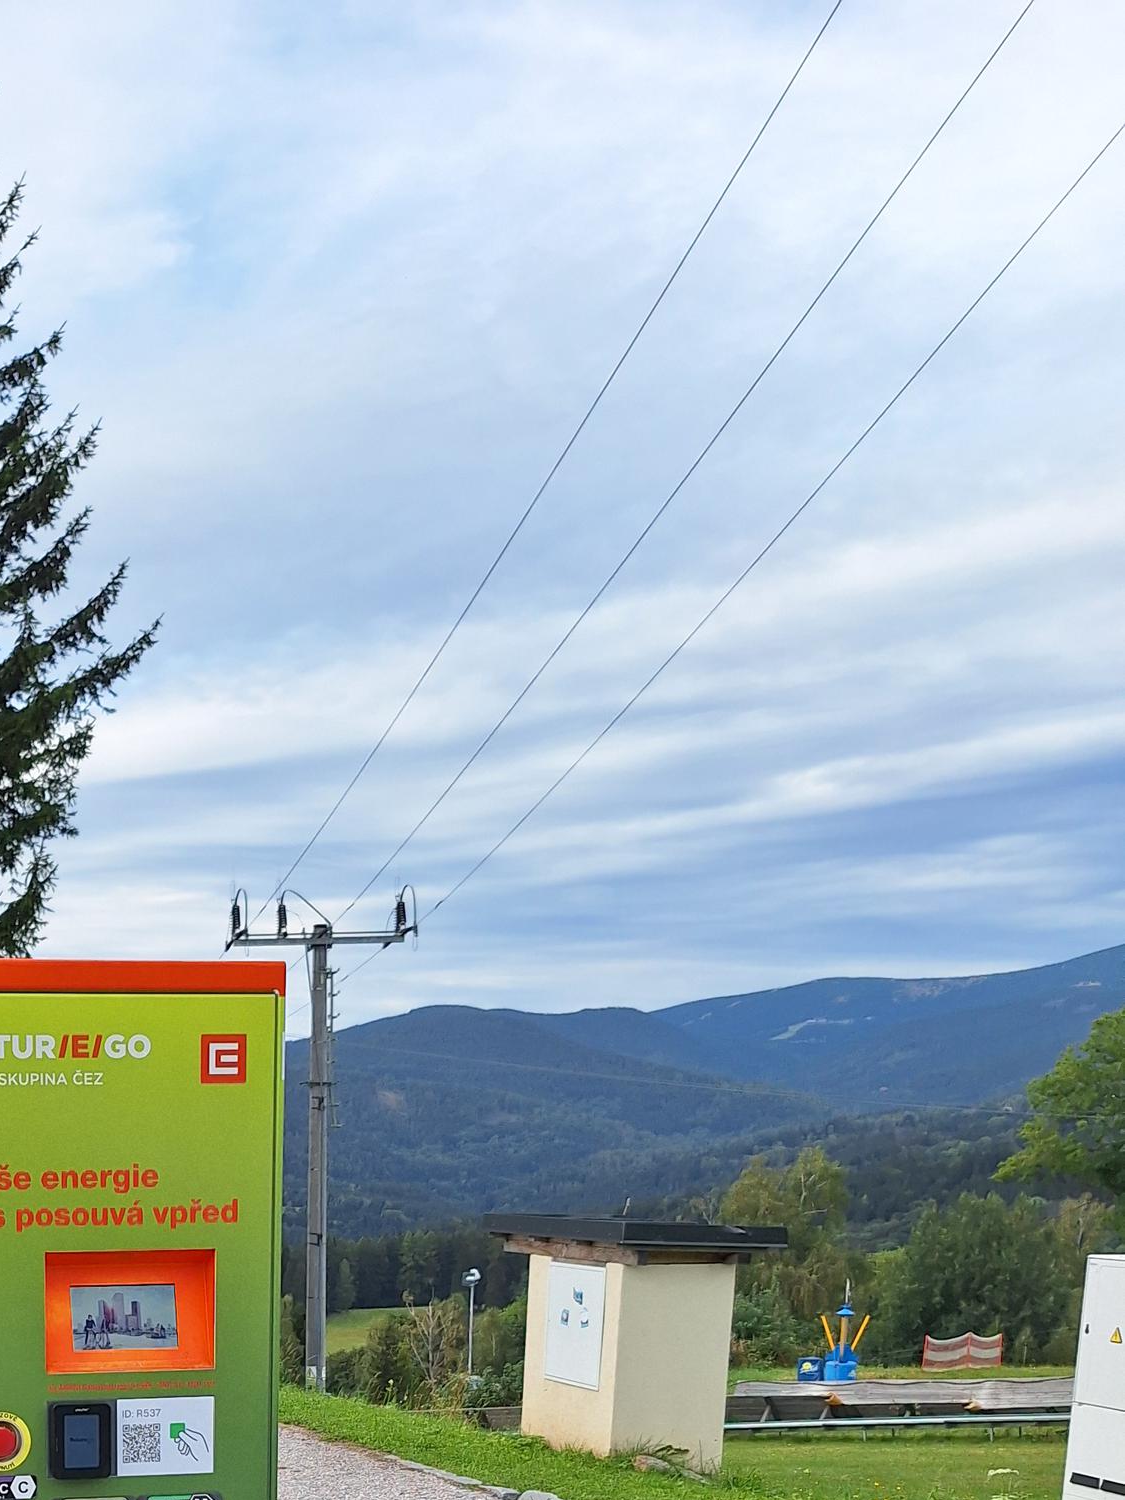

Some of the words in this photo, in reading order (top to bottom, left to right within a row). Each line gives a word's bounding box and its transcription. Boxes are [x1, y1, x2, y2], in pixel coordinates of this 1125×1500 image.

[72, 1069, 104, 1086] ČEZ
[41, 1163, 159, 1193] energie
[16, 1200, 144, 1232] posouvá
[152, 1198, 239, 1230] vpřed
[122, 1409, 134, 1418] ID:
[136, 1408, 162, 1418] R537
[18, 1481, 29, 1494] C
